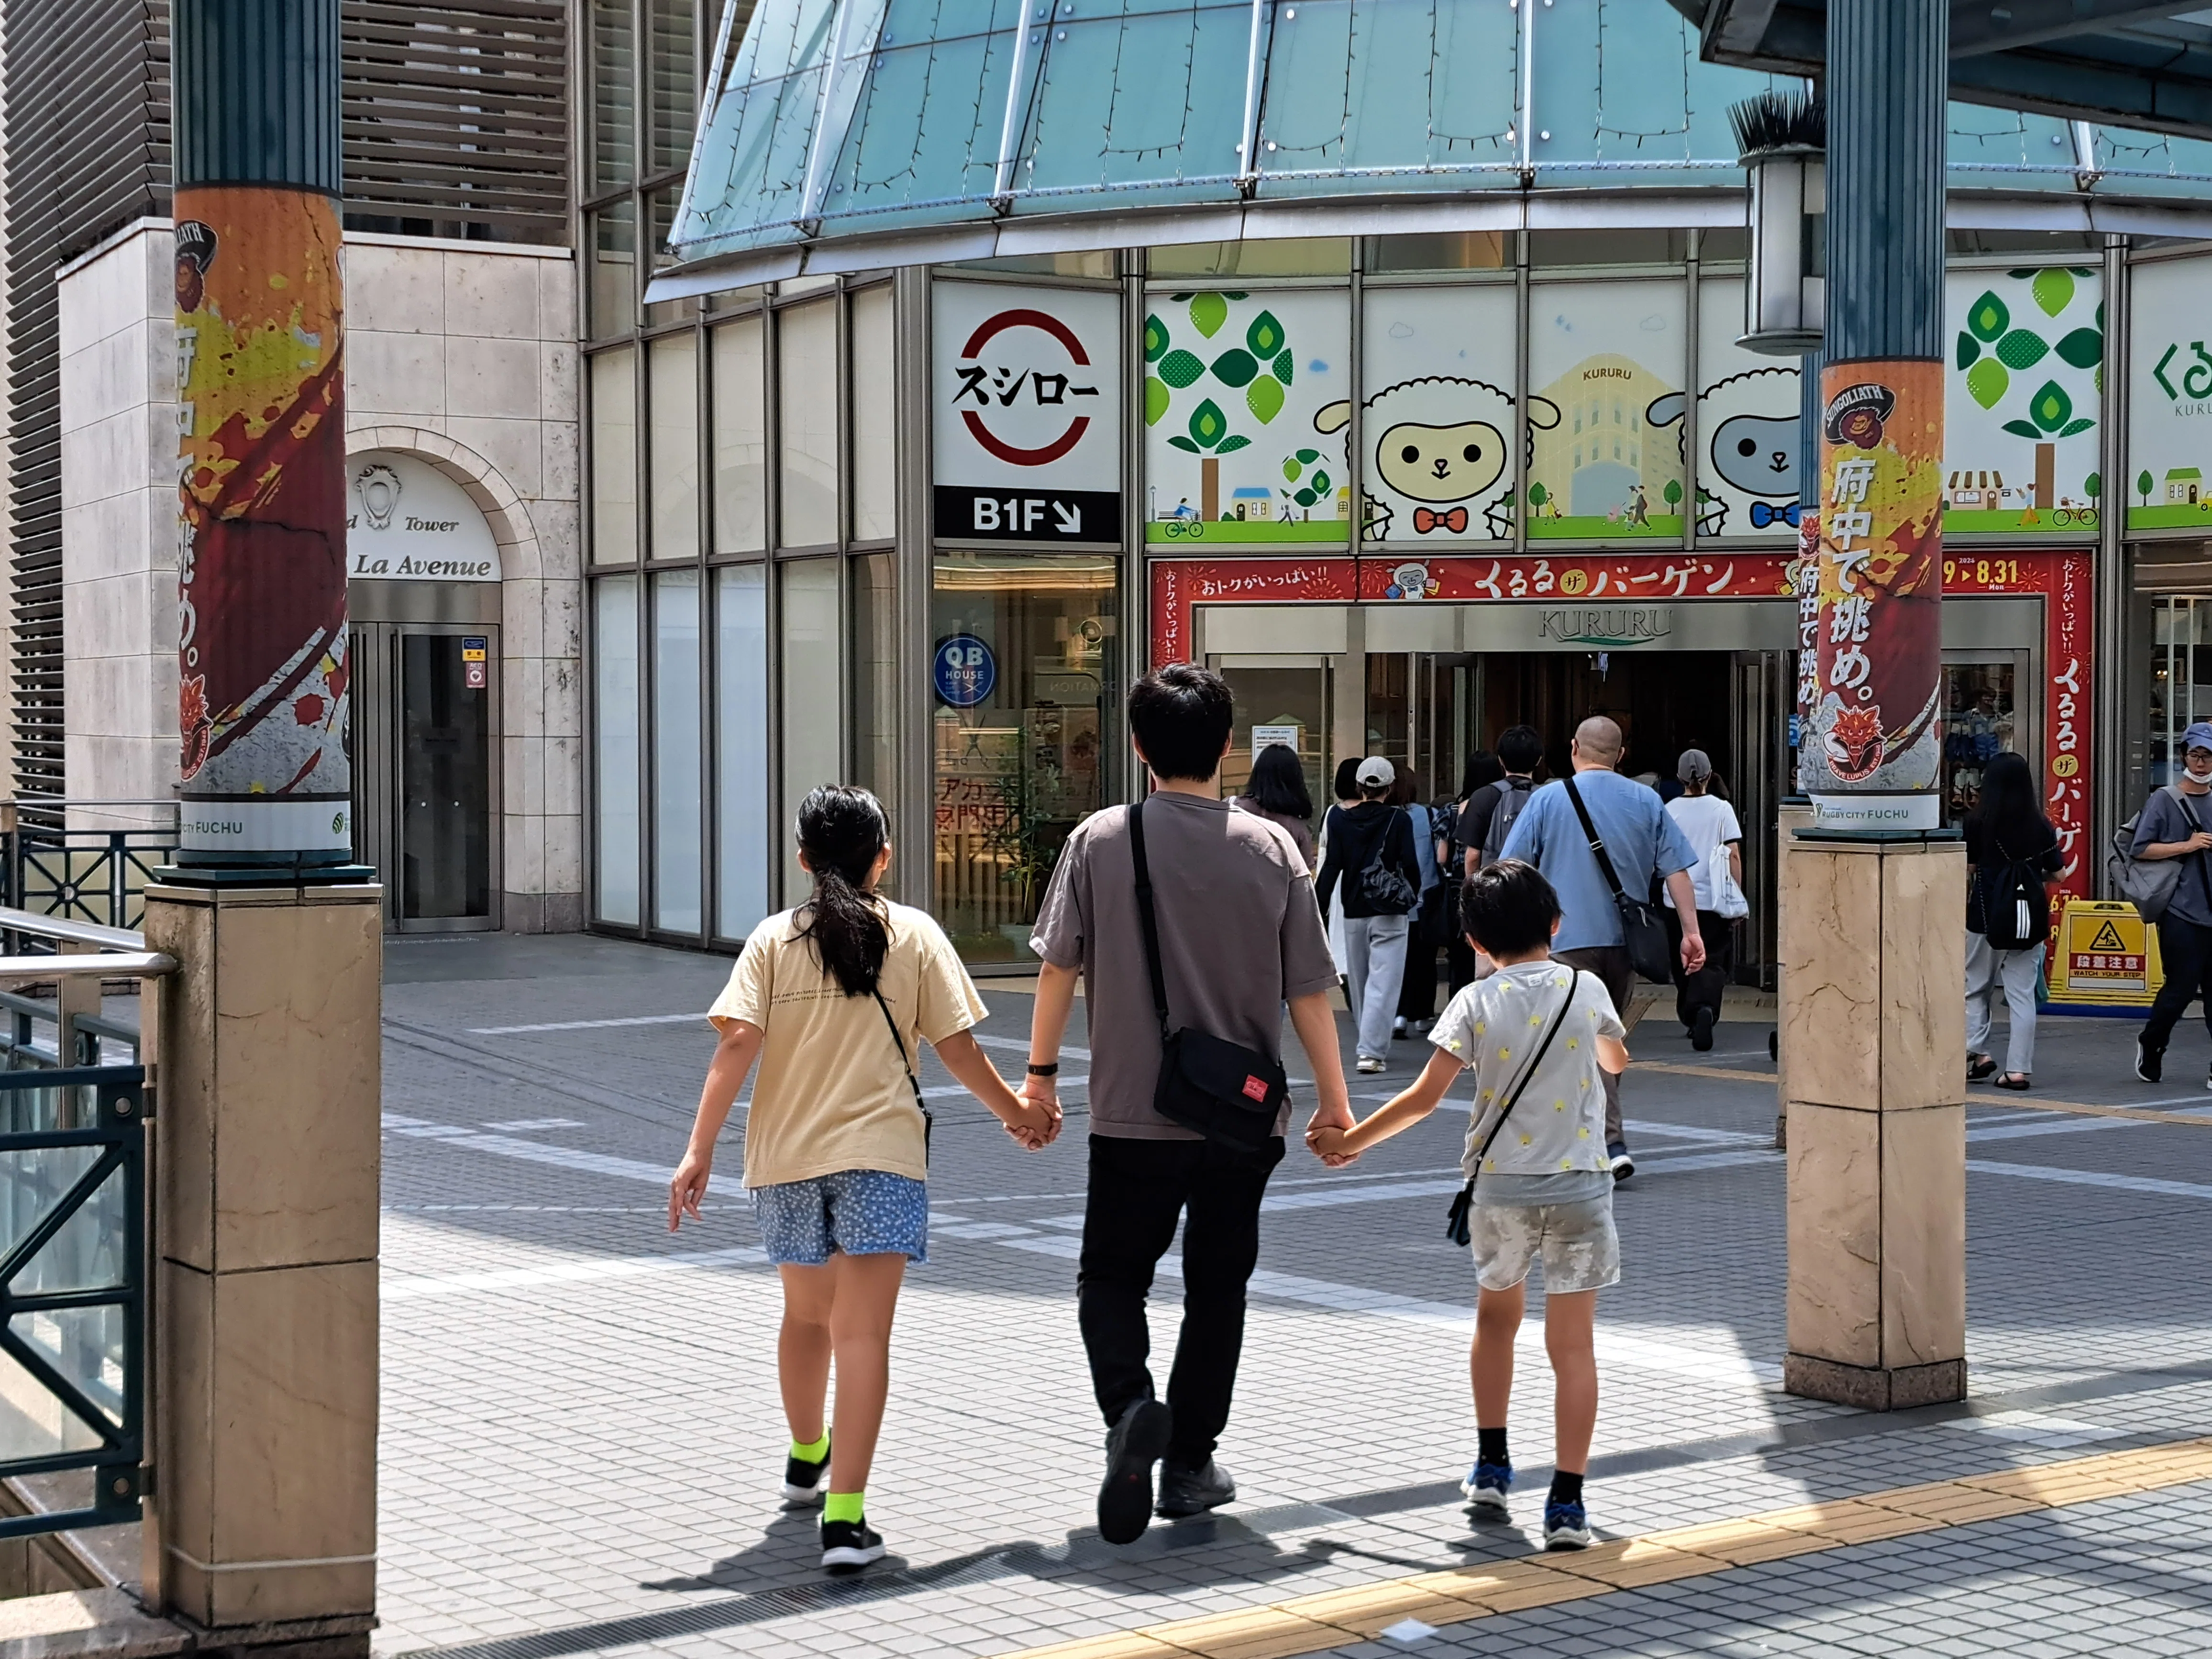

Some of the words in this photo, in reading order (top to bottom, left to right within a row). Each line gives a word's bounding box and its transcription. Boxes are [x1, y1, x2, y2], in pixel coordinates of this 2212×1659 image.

[1583, 368, 1632, 381] KURURU
[951, 365, 1099, 407] スシロー
[1826, 385, 1884, 426] SUNGOLIATH
[405, 517, 459, 531] Tower
[974, 498, 1046, 531] B1F
[354, 555, 389, 574] La
[397, 555, 491, 575] Avenue
[1977, 560, 2017, 584] 8.31
[1830, 456, 1877, 701] 府中で挑め。
[1538, 610, 1672, 642] KURURU
[945, 646, 984, 669] QB
[945, 671, 984, 679] HOUSE
[1847, 768, 1870, 780] LUPUS
[1868, 809, 1908, 818] FUCHU
[196, 821, 243, 834] FUCHU
